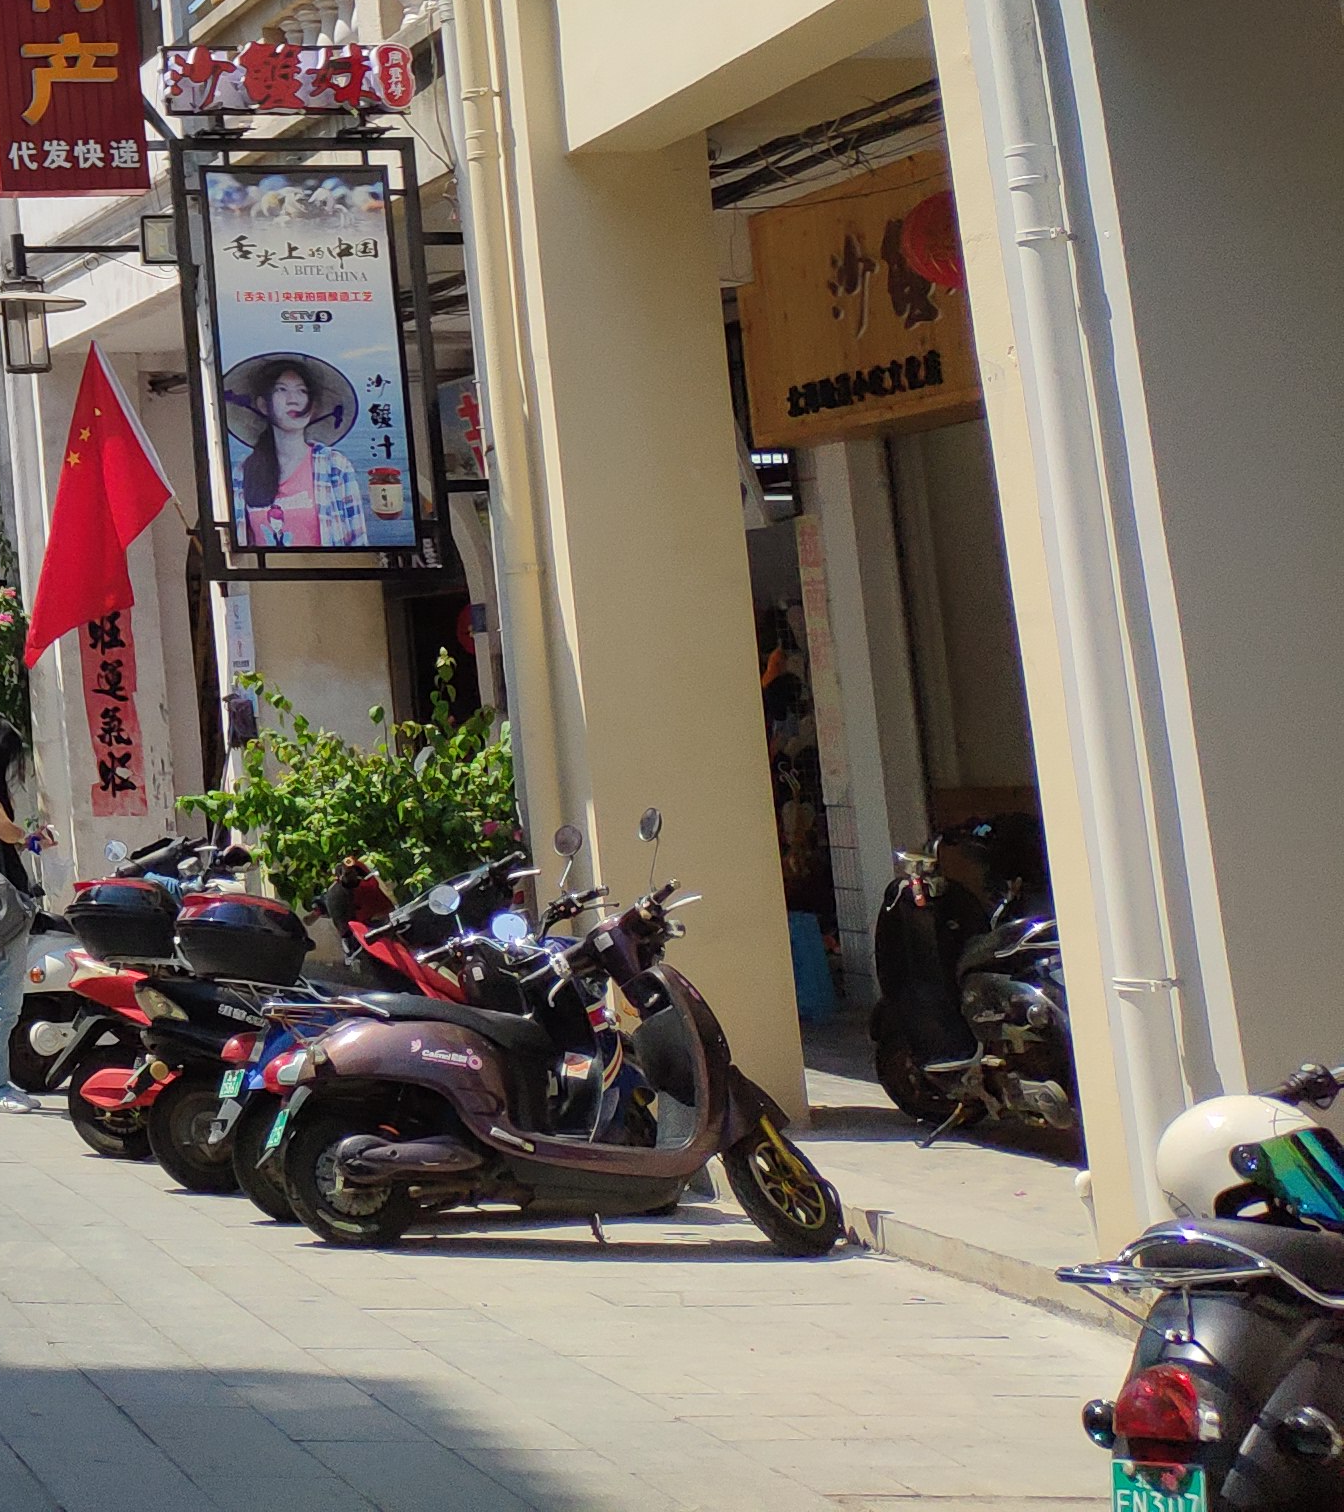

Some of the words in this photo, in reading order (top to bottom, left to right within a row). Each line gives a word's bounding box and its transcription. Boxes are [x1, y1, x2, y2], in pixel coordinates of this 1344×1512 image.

[7, 140, 142, 171] 代发快递
[223, 234, 380, 270] 舌尖上的中国
[295, 265, 325, 276] BITE
[325, 271, 368, 283] CHINA
